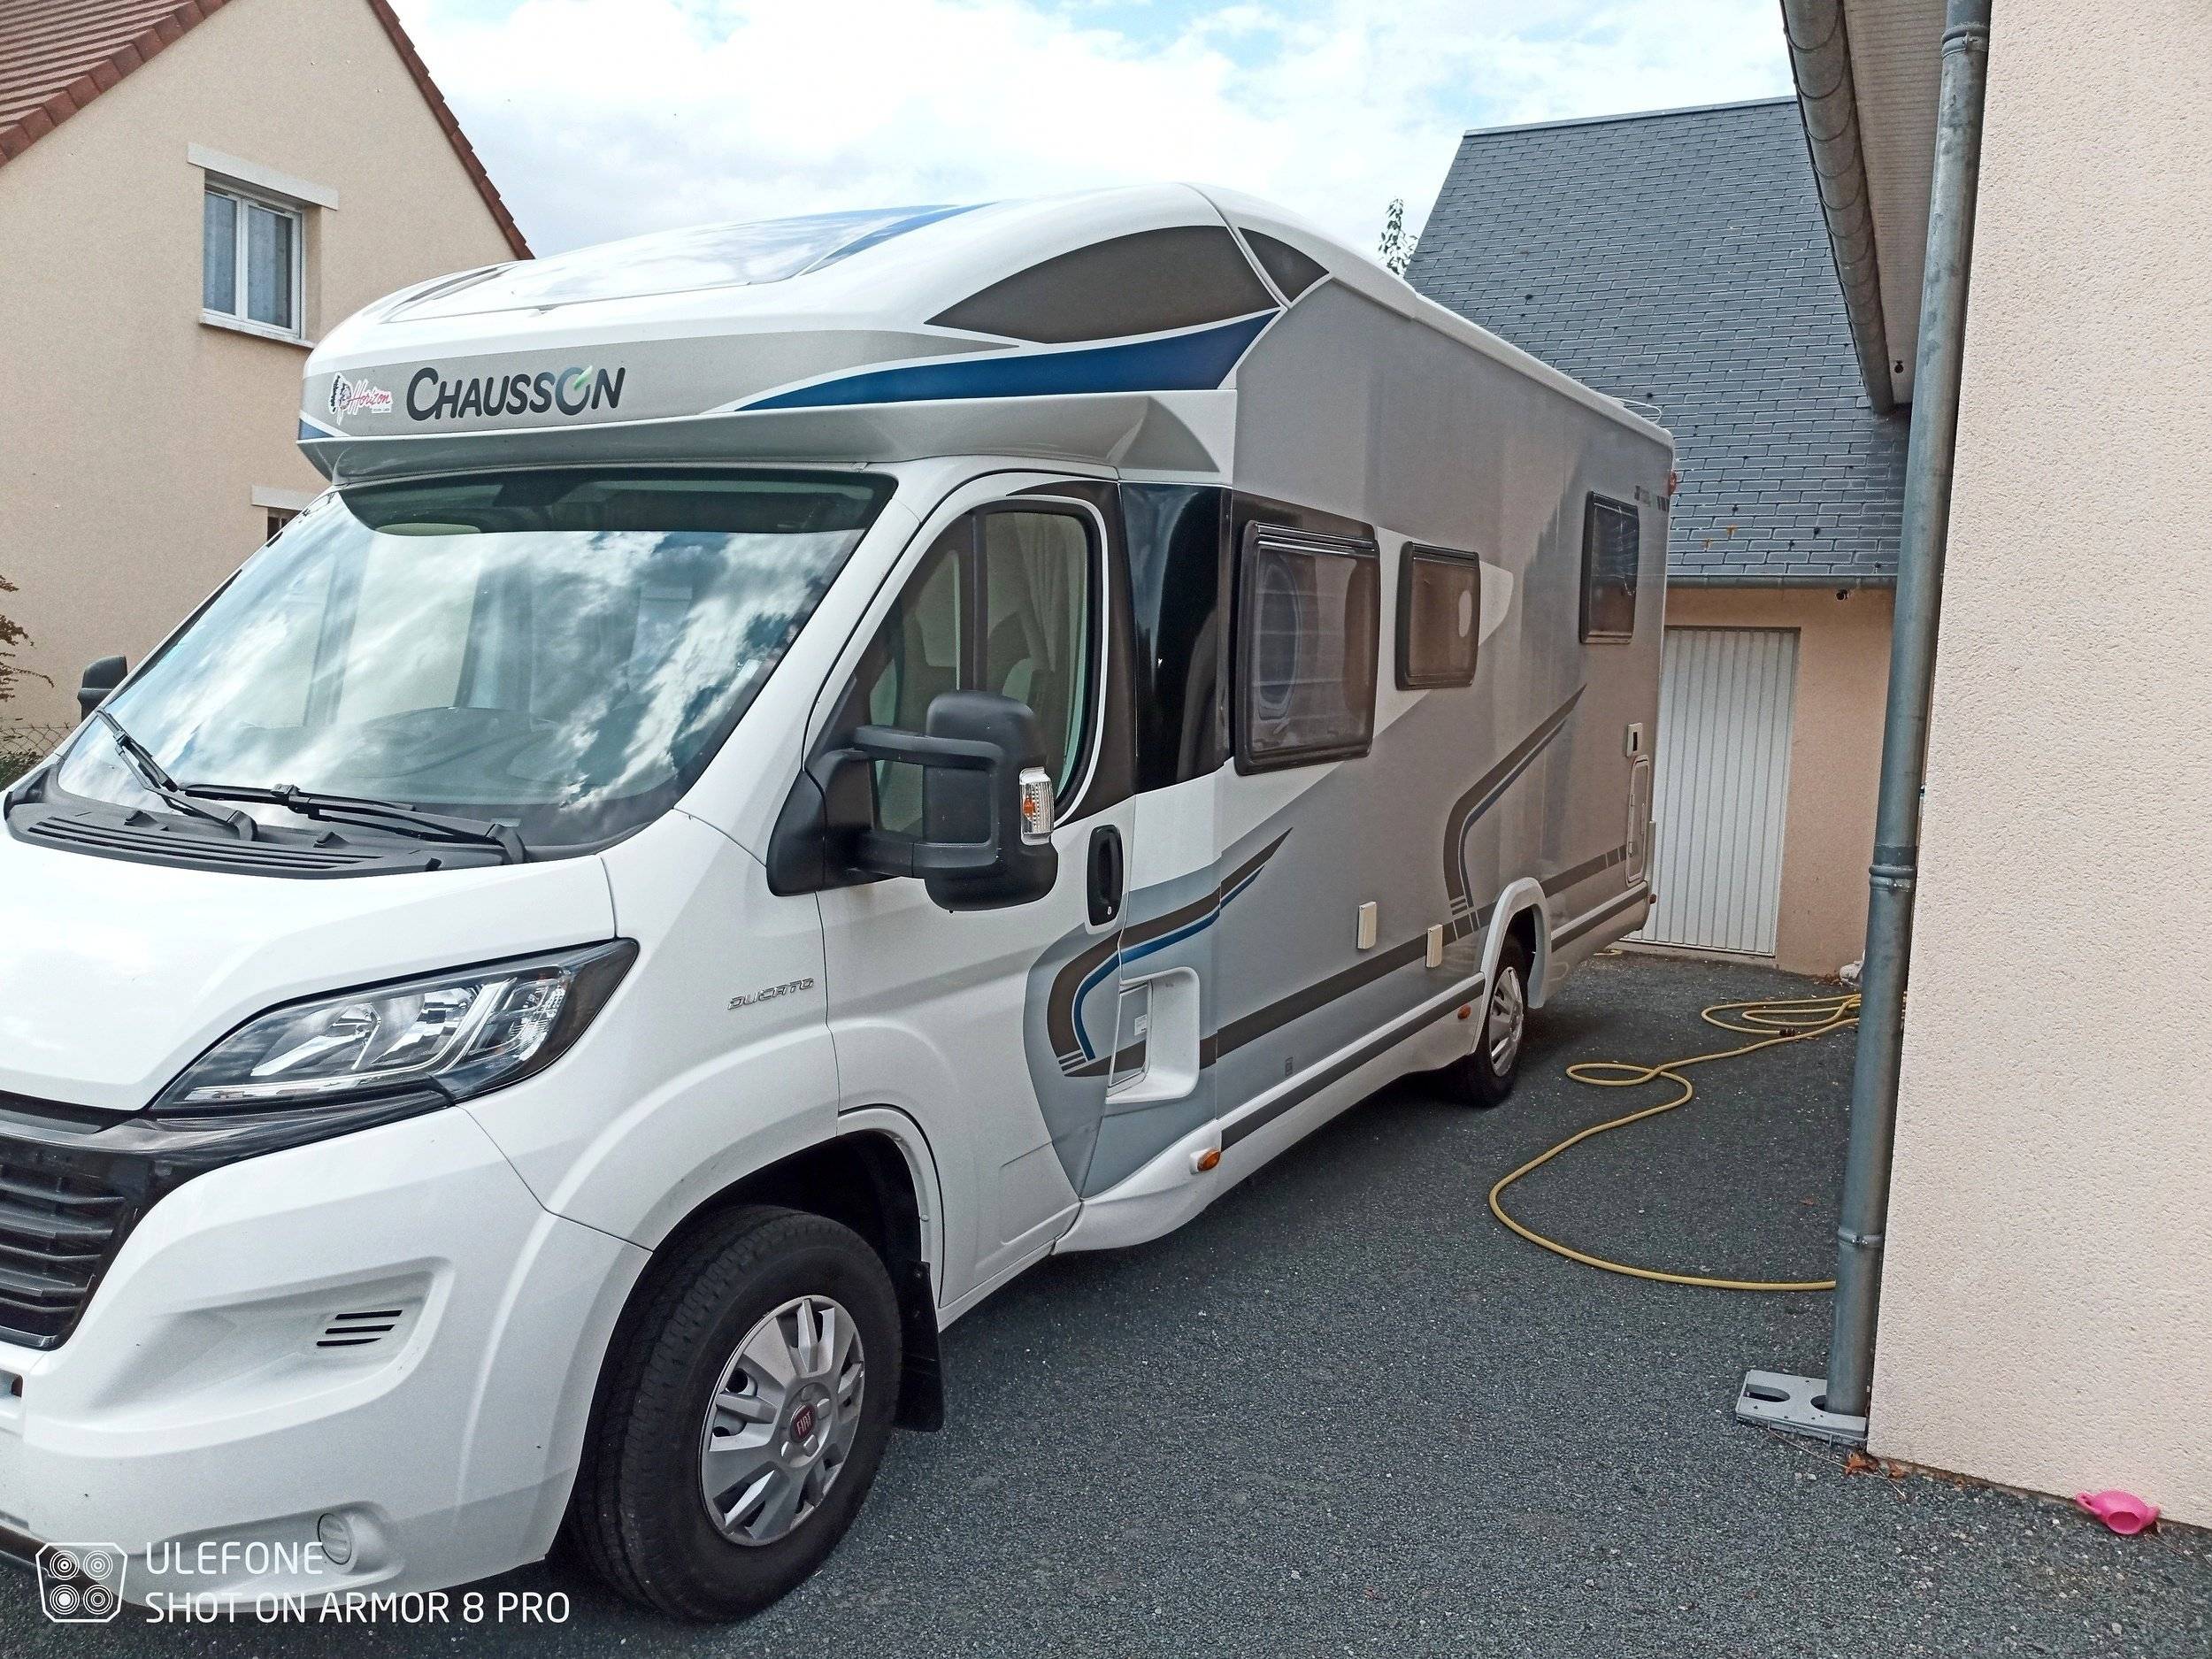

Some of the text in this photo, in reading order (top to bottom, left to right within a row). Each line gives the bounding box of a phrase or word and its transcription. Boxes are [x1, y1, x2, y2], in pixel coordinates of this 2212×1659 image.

[348, 381, 391, 414] Horizon
[406, 365, 626, 421] CHAUSSON
[726, 977, 814, 1010] DUCATO
[796, 1410, 811, 1435] FIAT
